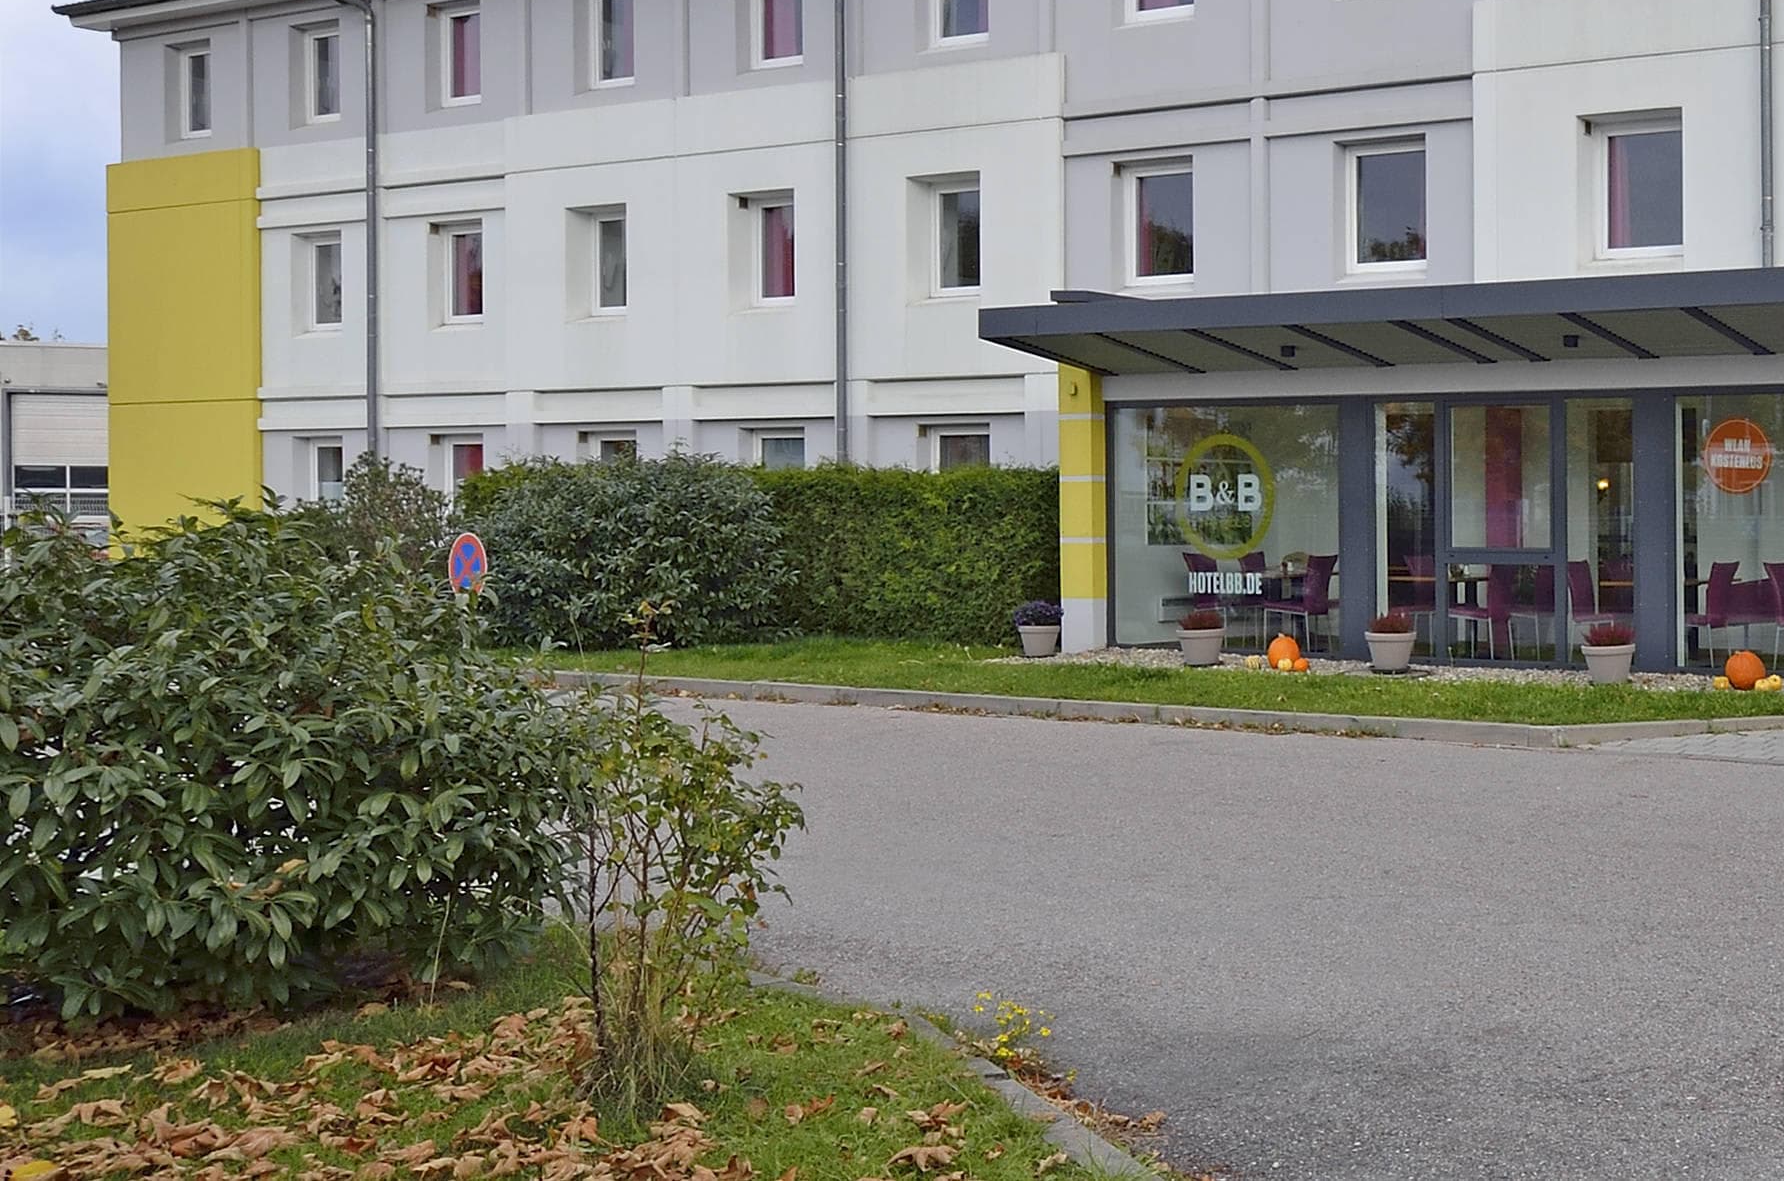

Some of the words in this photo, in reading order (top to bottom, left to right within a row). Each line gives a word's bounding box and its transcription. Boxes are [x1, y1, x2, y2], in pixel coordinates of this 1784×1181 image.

[1724, 438, 1751, 452] WLAN
[1710, 453, 1763, 469] KOSTENLOS
[1189, 474, 1262, 511] B&B
[1188, 571, 1263, 595] HOTELBB.DE
